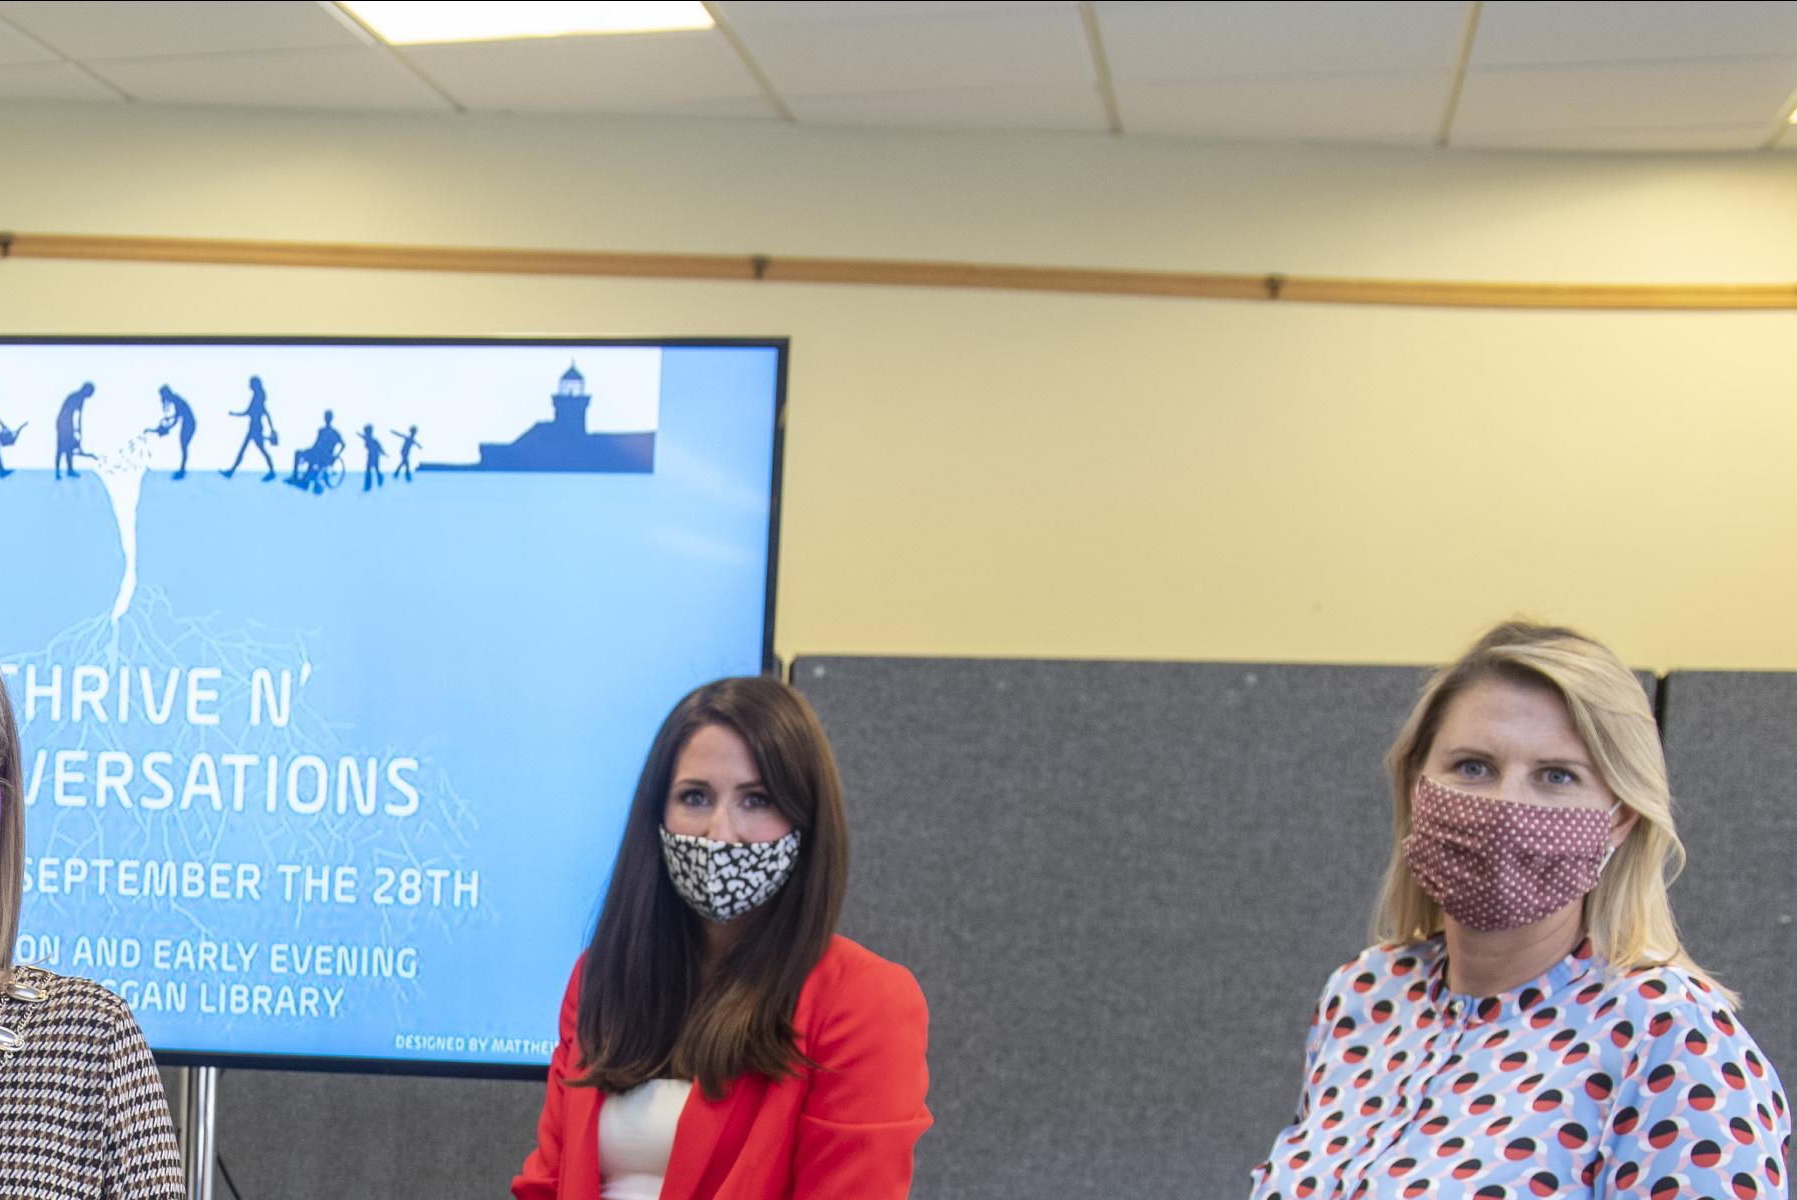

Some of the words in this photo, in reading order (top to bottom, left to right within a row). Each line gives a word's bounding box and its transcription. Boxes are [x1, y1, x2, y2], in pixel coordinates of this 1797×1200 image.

[278, 865, 357, 903] THE
[373, 868, 480, 908] 28TH
[73, 936, 141, 968] AND
[155, 938, 258, 974] EARLY
[270, 944, 418, 979] EVENING
[200, 982, 344, 1017] LIBRARY
[395, 1034, 465, 1051] DESIGNED
[468, 1038, 487, 1052] BY
